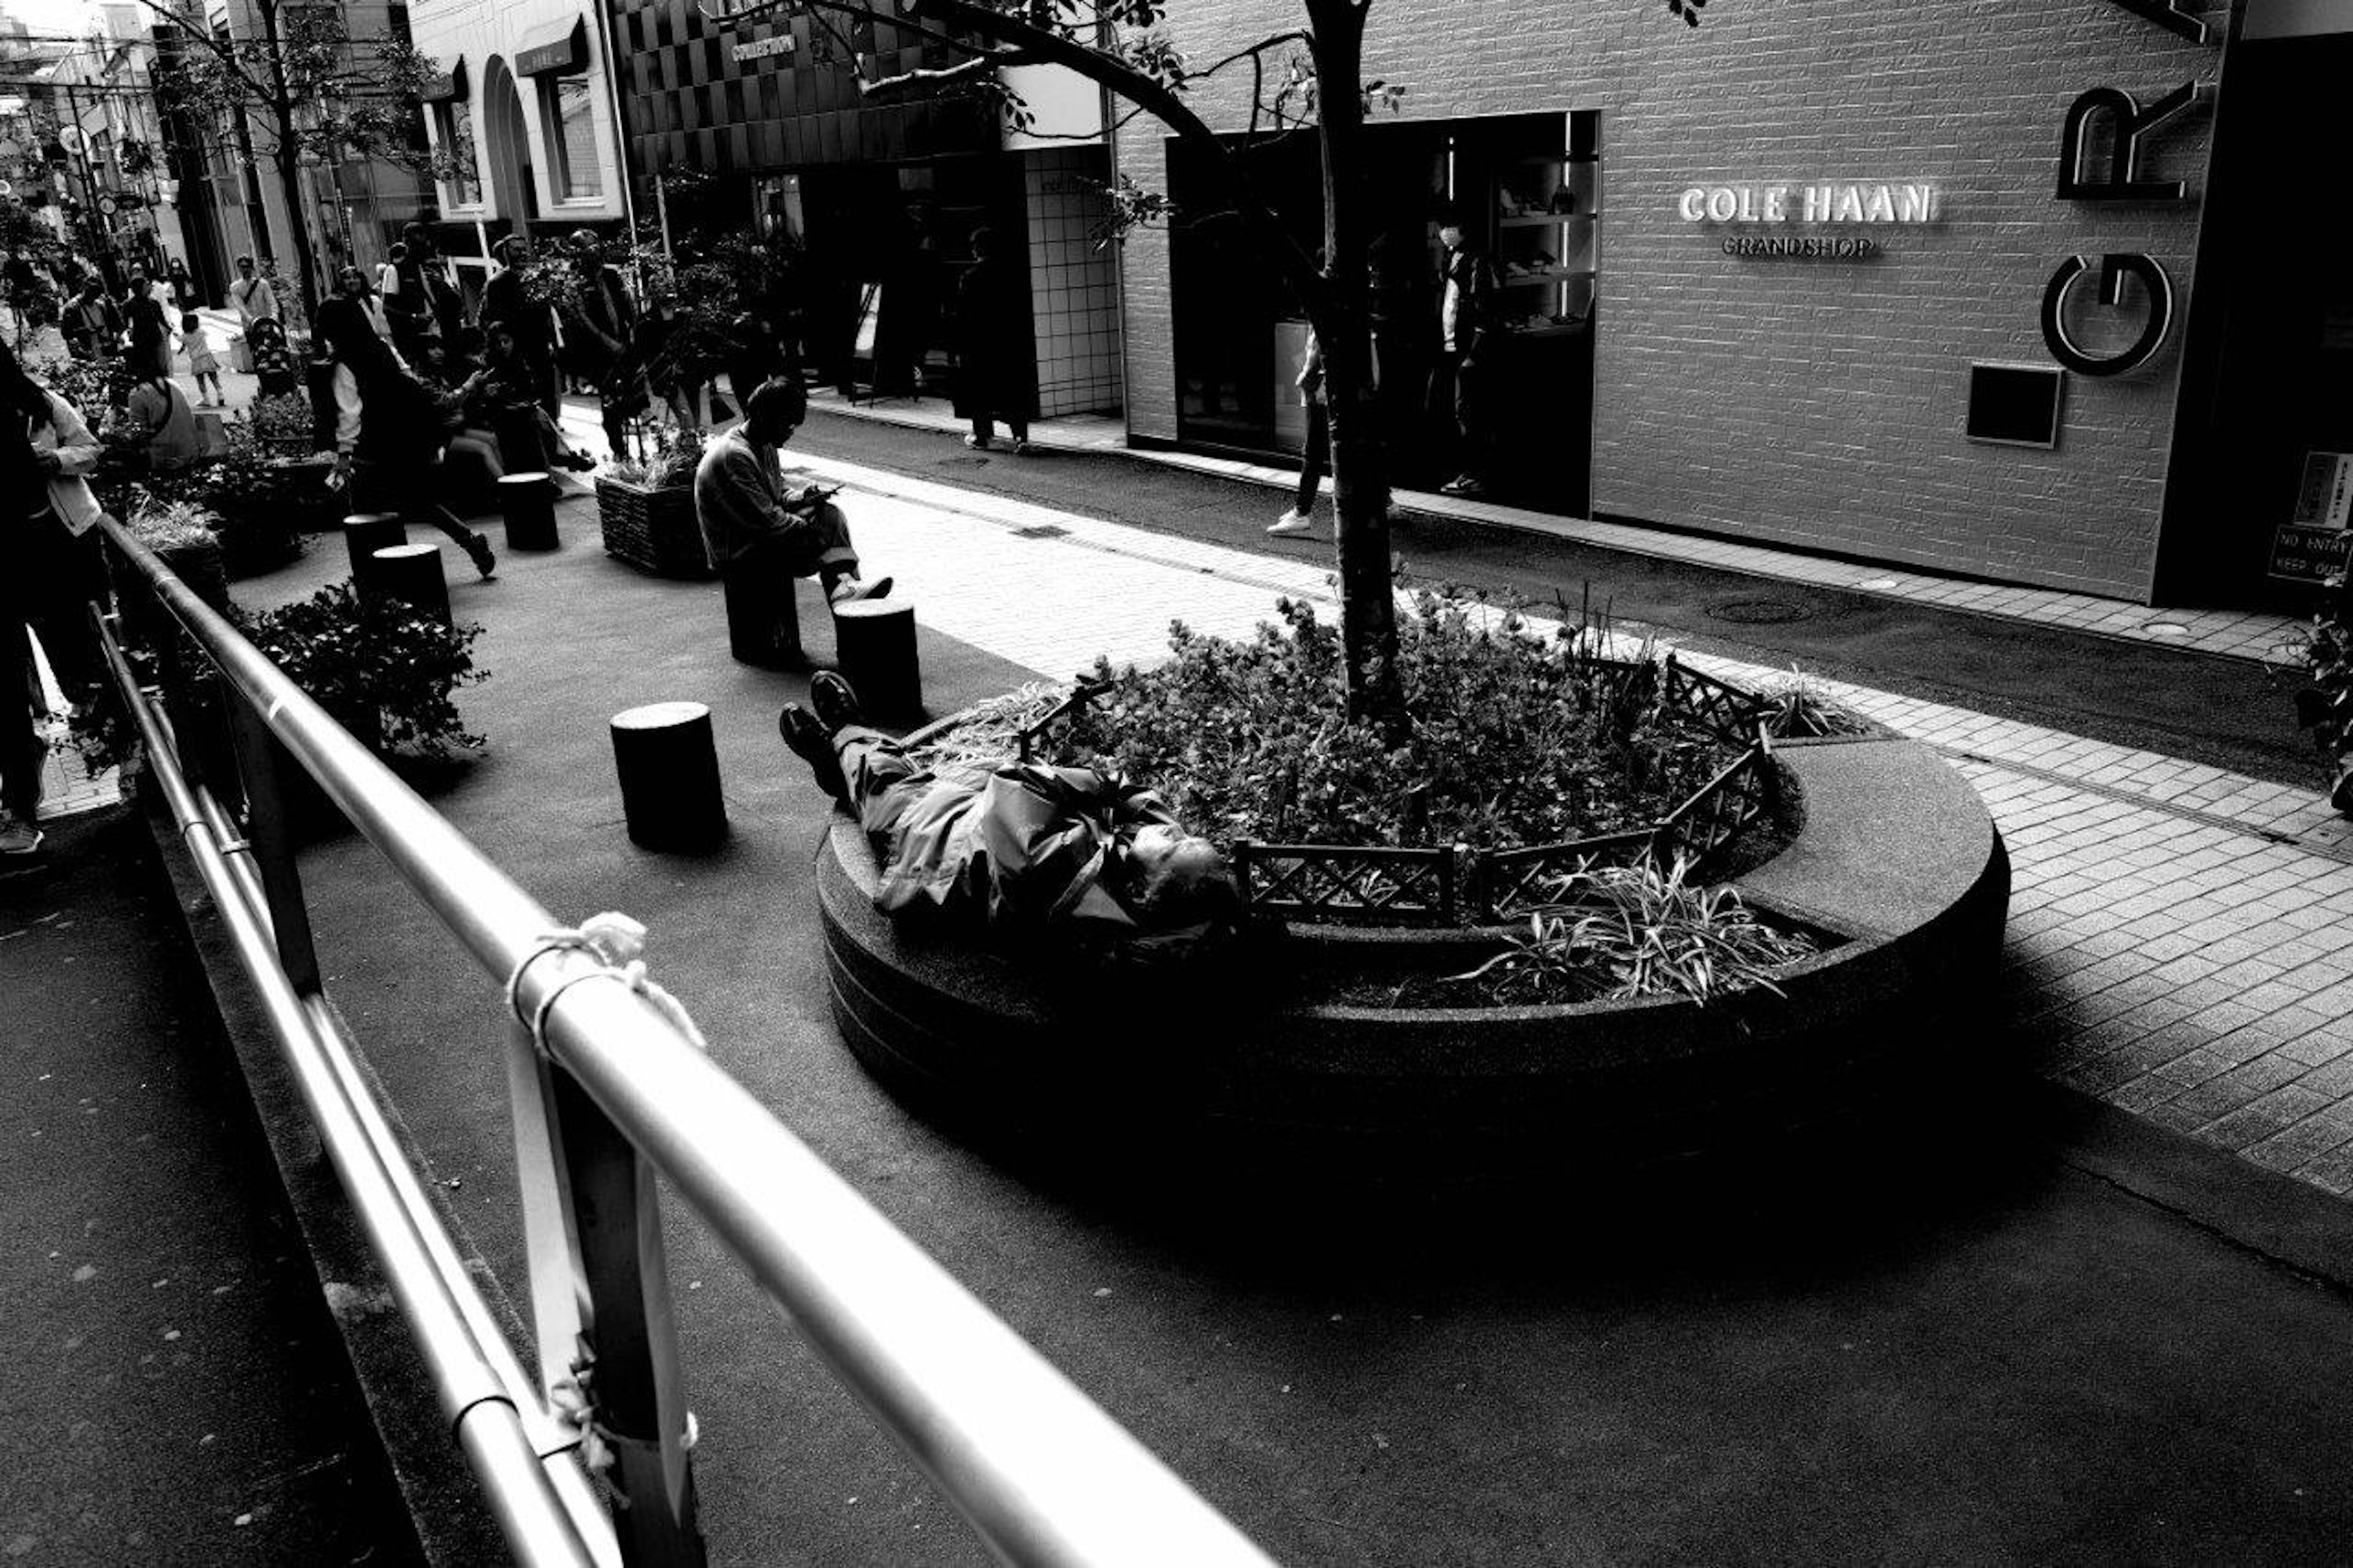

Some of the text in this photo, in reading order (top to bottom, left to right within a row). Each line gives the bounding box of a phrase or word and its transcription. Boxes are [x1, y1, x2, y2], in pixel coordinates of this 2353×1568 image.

[1679, 185, 1930, 222] COLE HAAN
[2279, 534, 2299, 547] NO
